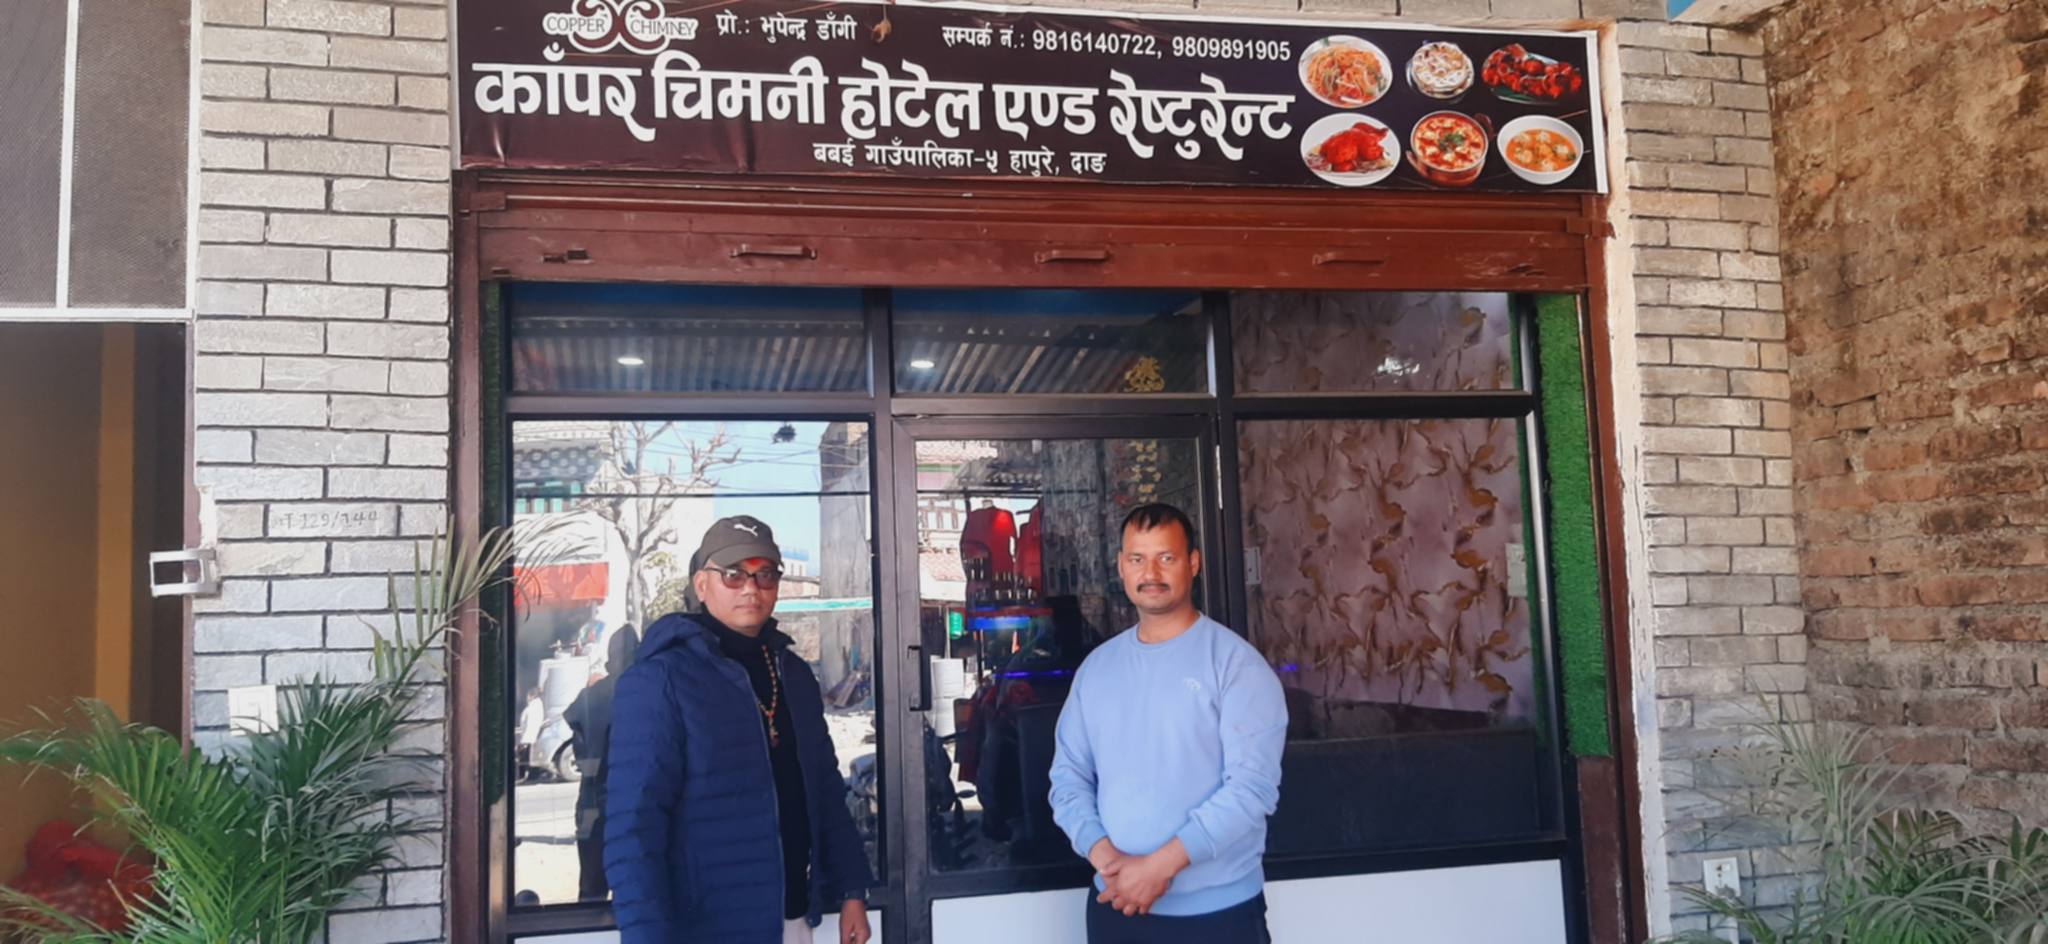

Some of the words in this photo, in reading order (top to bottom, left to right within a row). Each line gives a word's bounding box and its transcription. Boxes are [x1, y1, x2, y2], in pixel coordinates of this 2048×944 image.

[546, 15, 606, 33] COPPER
[630, 19, 695, 36] CHIMNEY
[760, 12, 808, 43] भुपेन्द्र
[815, 11, 858, 41] डाँगी
[942, 22, 993, 47] सम्पर्क
[1032, 29, 1163, 59] 9816140722,
[1172, 36, 1291, 61] 9809891905
[650, 50, 830, 124] चिमनी
[838, 58, 984, 140] होटेल
[991, 83, 1100, 140] एण्ड
[1107, 69, 1296, 161] रेष्टुरेन्ट
[812, 138, 857, 167] बबई
